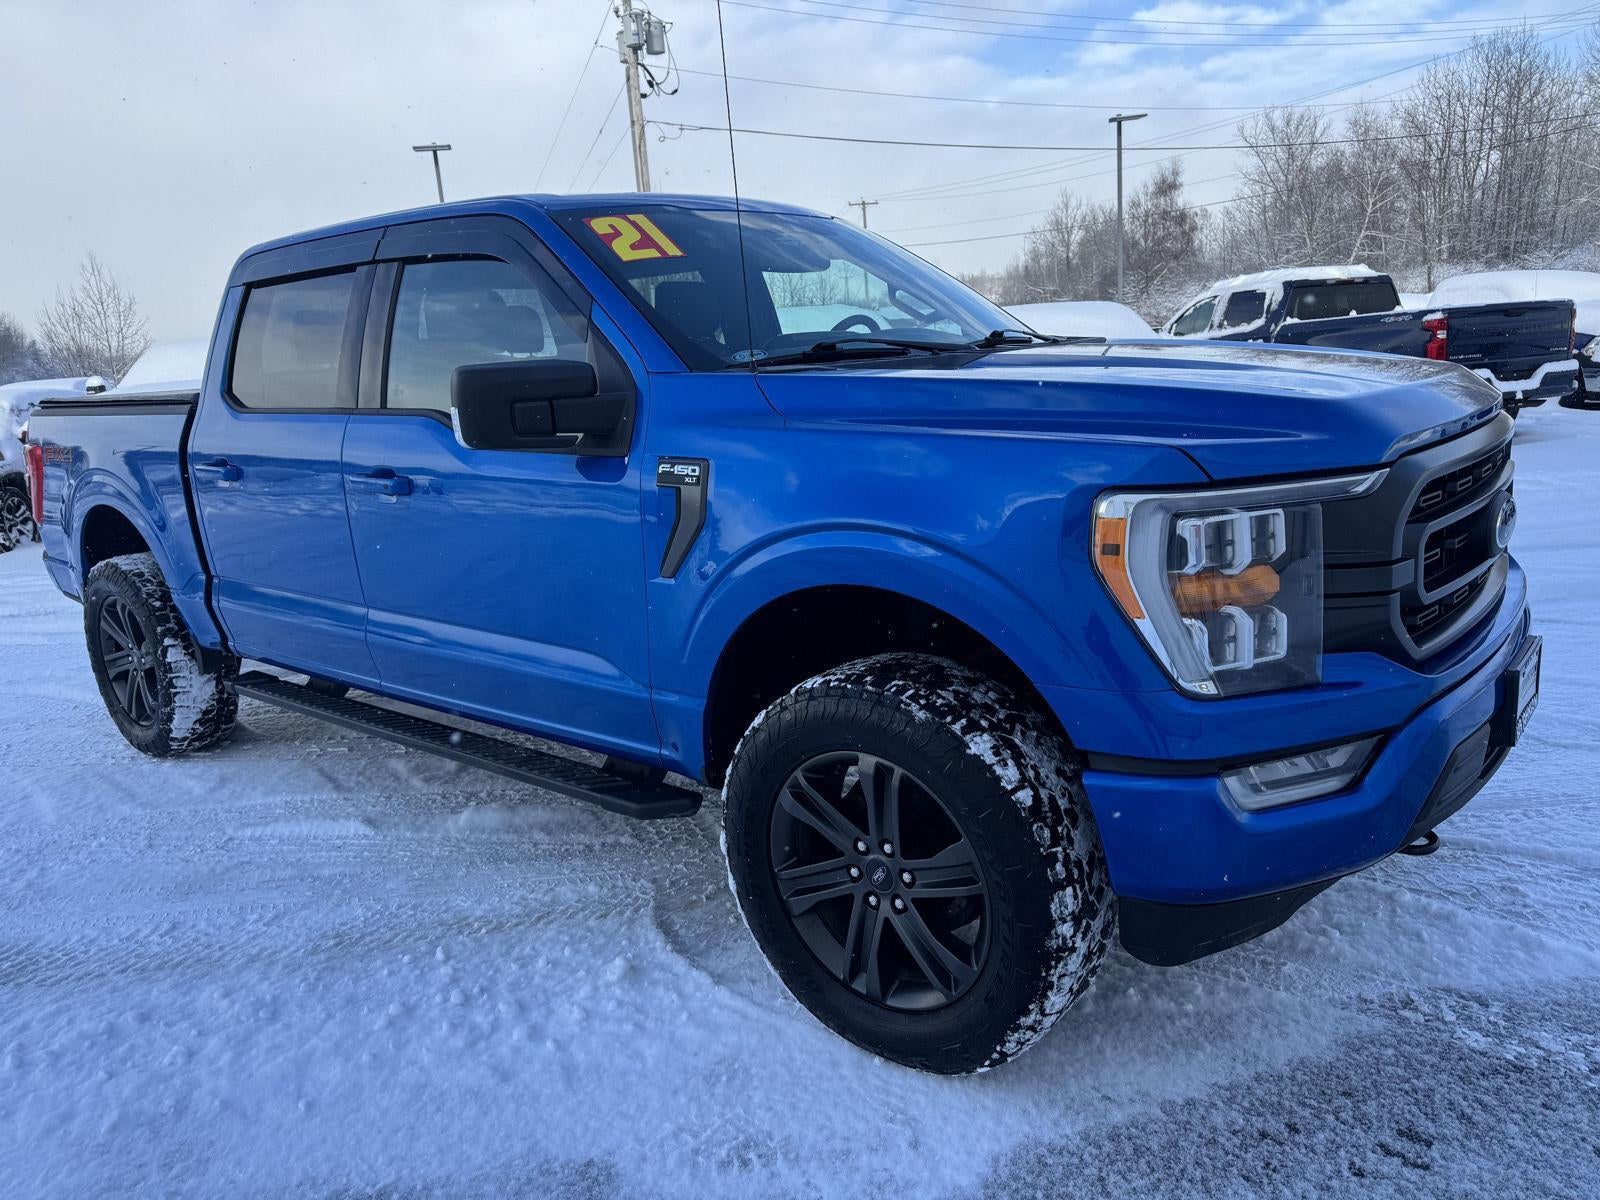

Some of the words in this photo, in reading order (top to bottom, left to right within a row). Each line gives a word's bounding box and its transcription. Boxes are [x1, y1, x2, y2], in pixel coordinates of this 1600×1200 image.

[591, 214, 683, 262] 21
[45, 447, 72, 464] FX4
[659, 464, 700, 476] F-150
